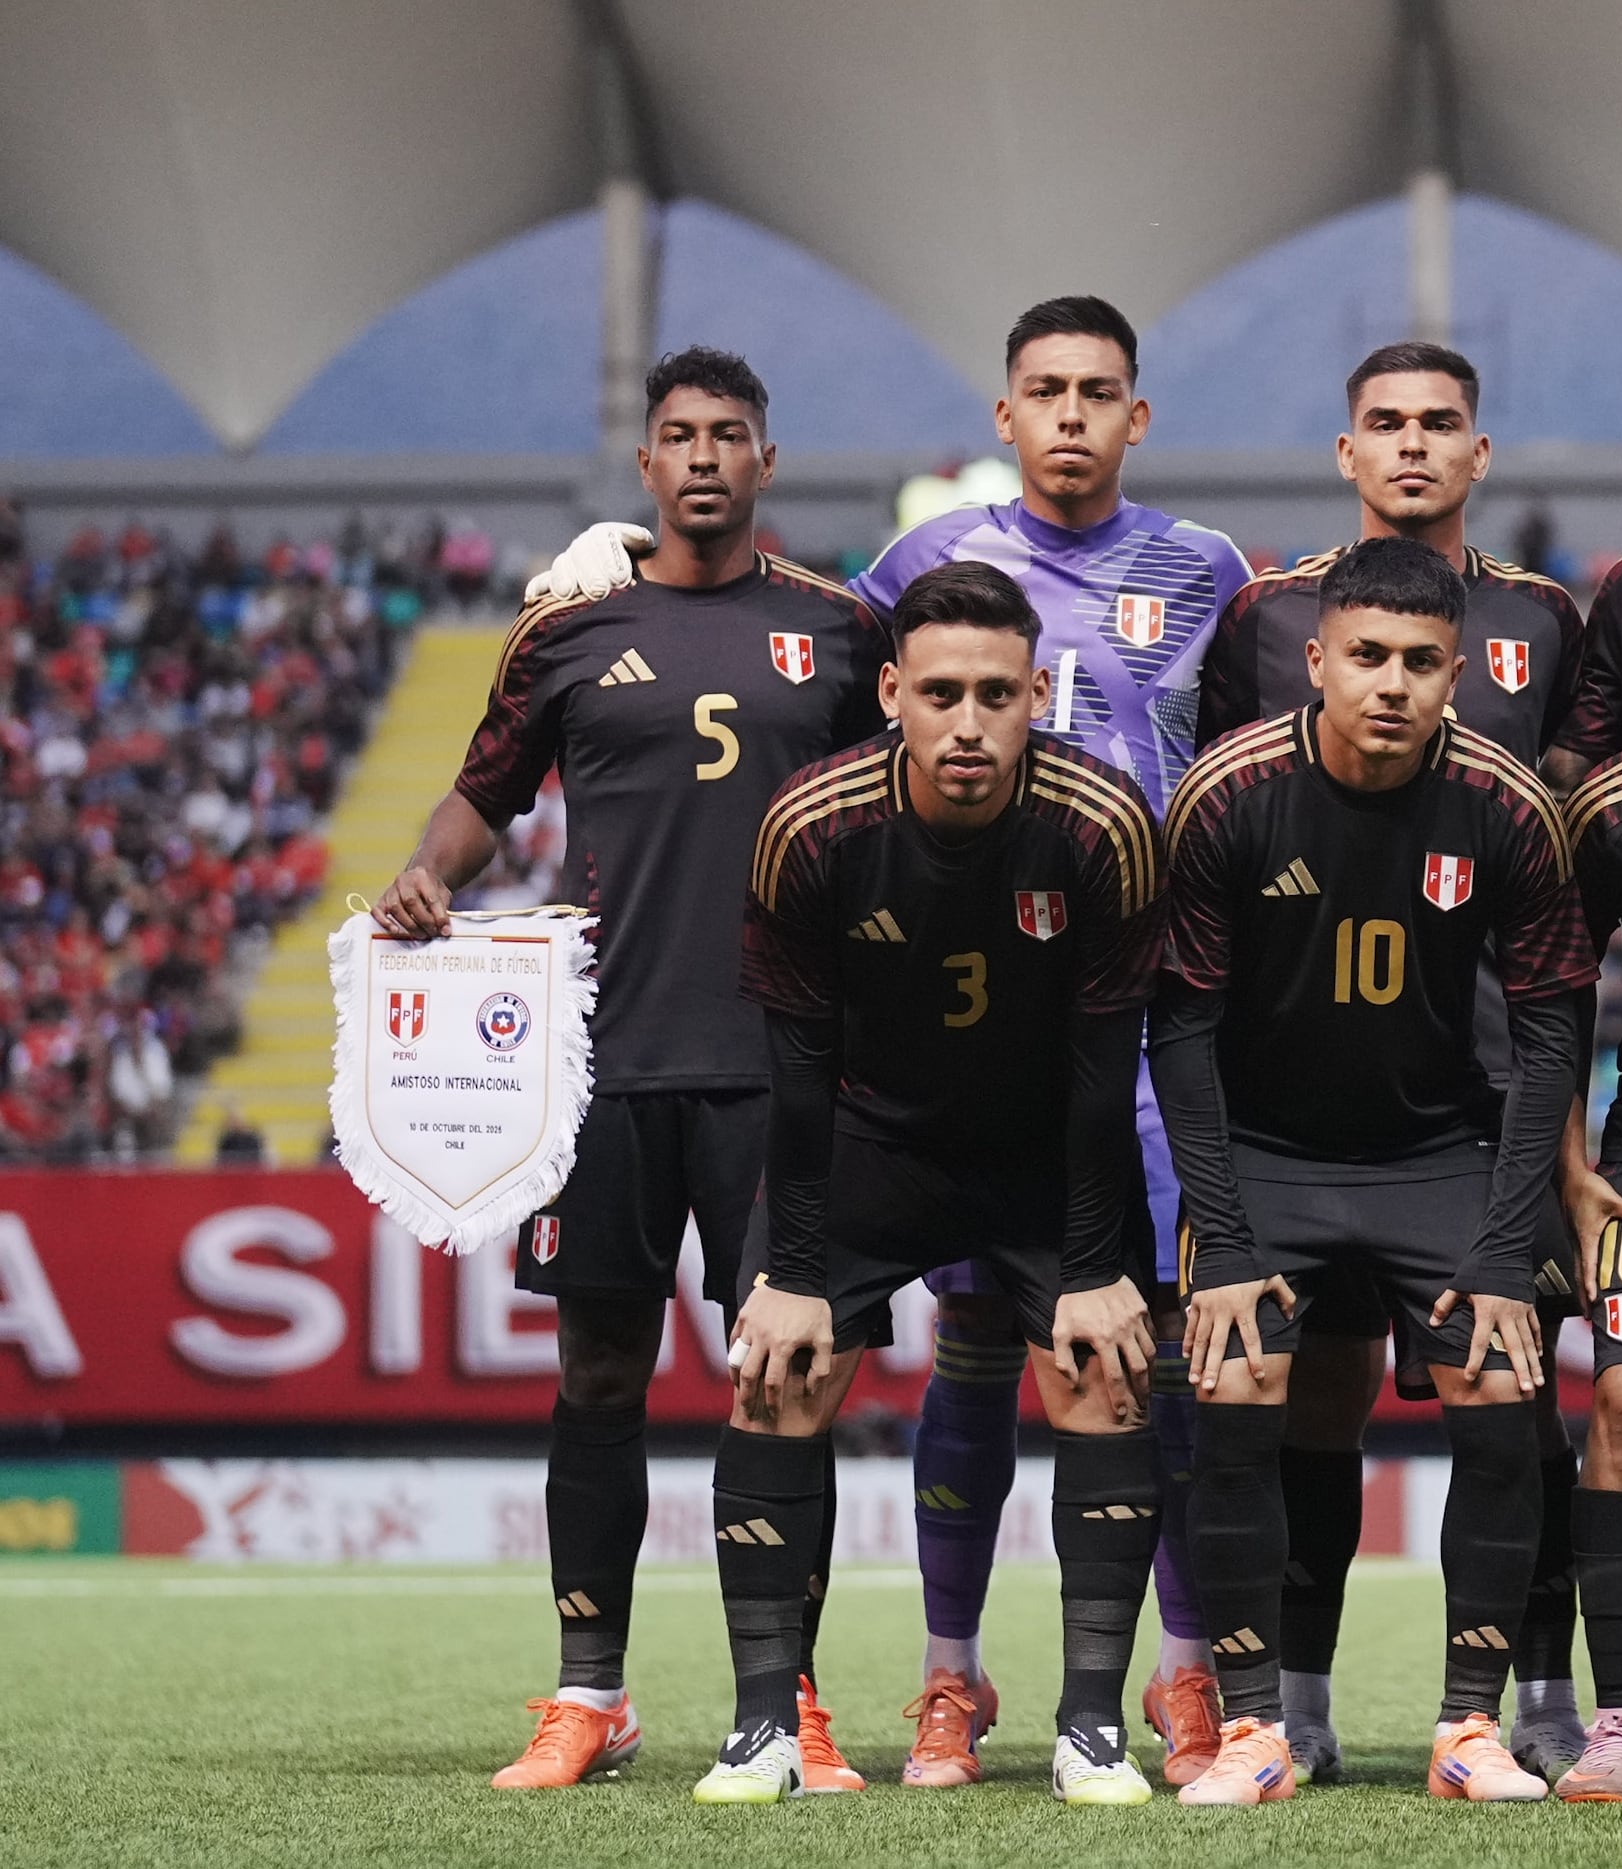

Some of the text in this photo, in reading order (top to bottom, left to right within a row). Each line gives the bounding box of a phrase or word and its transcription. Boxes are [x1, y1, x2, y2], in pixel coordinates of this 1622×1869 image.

[1055, 649, 1077, 732] 1
[694, 693, 740, 781] 5
[1430, 872, 1467, 886] FPF
[1024, 907, 1060, 918] FPF
[443, 956, 486, 973] PERUANA
[491, 957, 503, 974] DE
[507, 951, 543, 975] FÚTBOL
[1334, 917, 1406, 1005] 10
[942, 951, 989, 1027] 3
[391, 1007, 424, 1022] FPF
[393, 1049, 418, 1061] PERÚ
[486, 1054, 516, 1063] CHILE
[390, 1075, 522, 1092] AMISTOSO INTERNACIONAL
[420, 1123, 429, 1132] DE
[432, 1123, 466, 1133] OCTUBRE
[469, 1124, 482, 1134] DEL
[445, 1140, 465, 1150] CHILE
